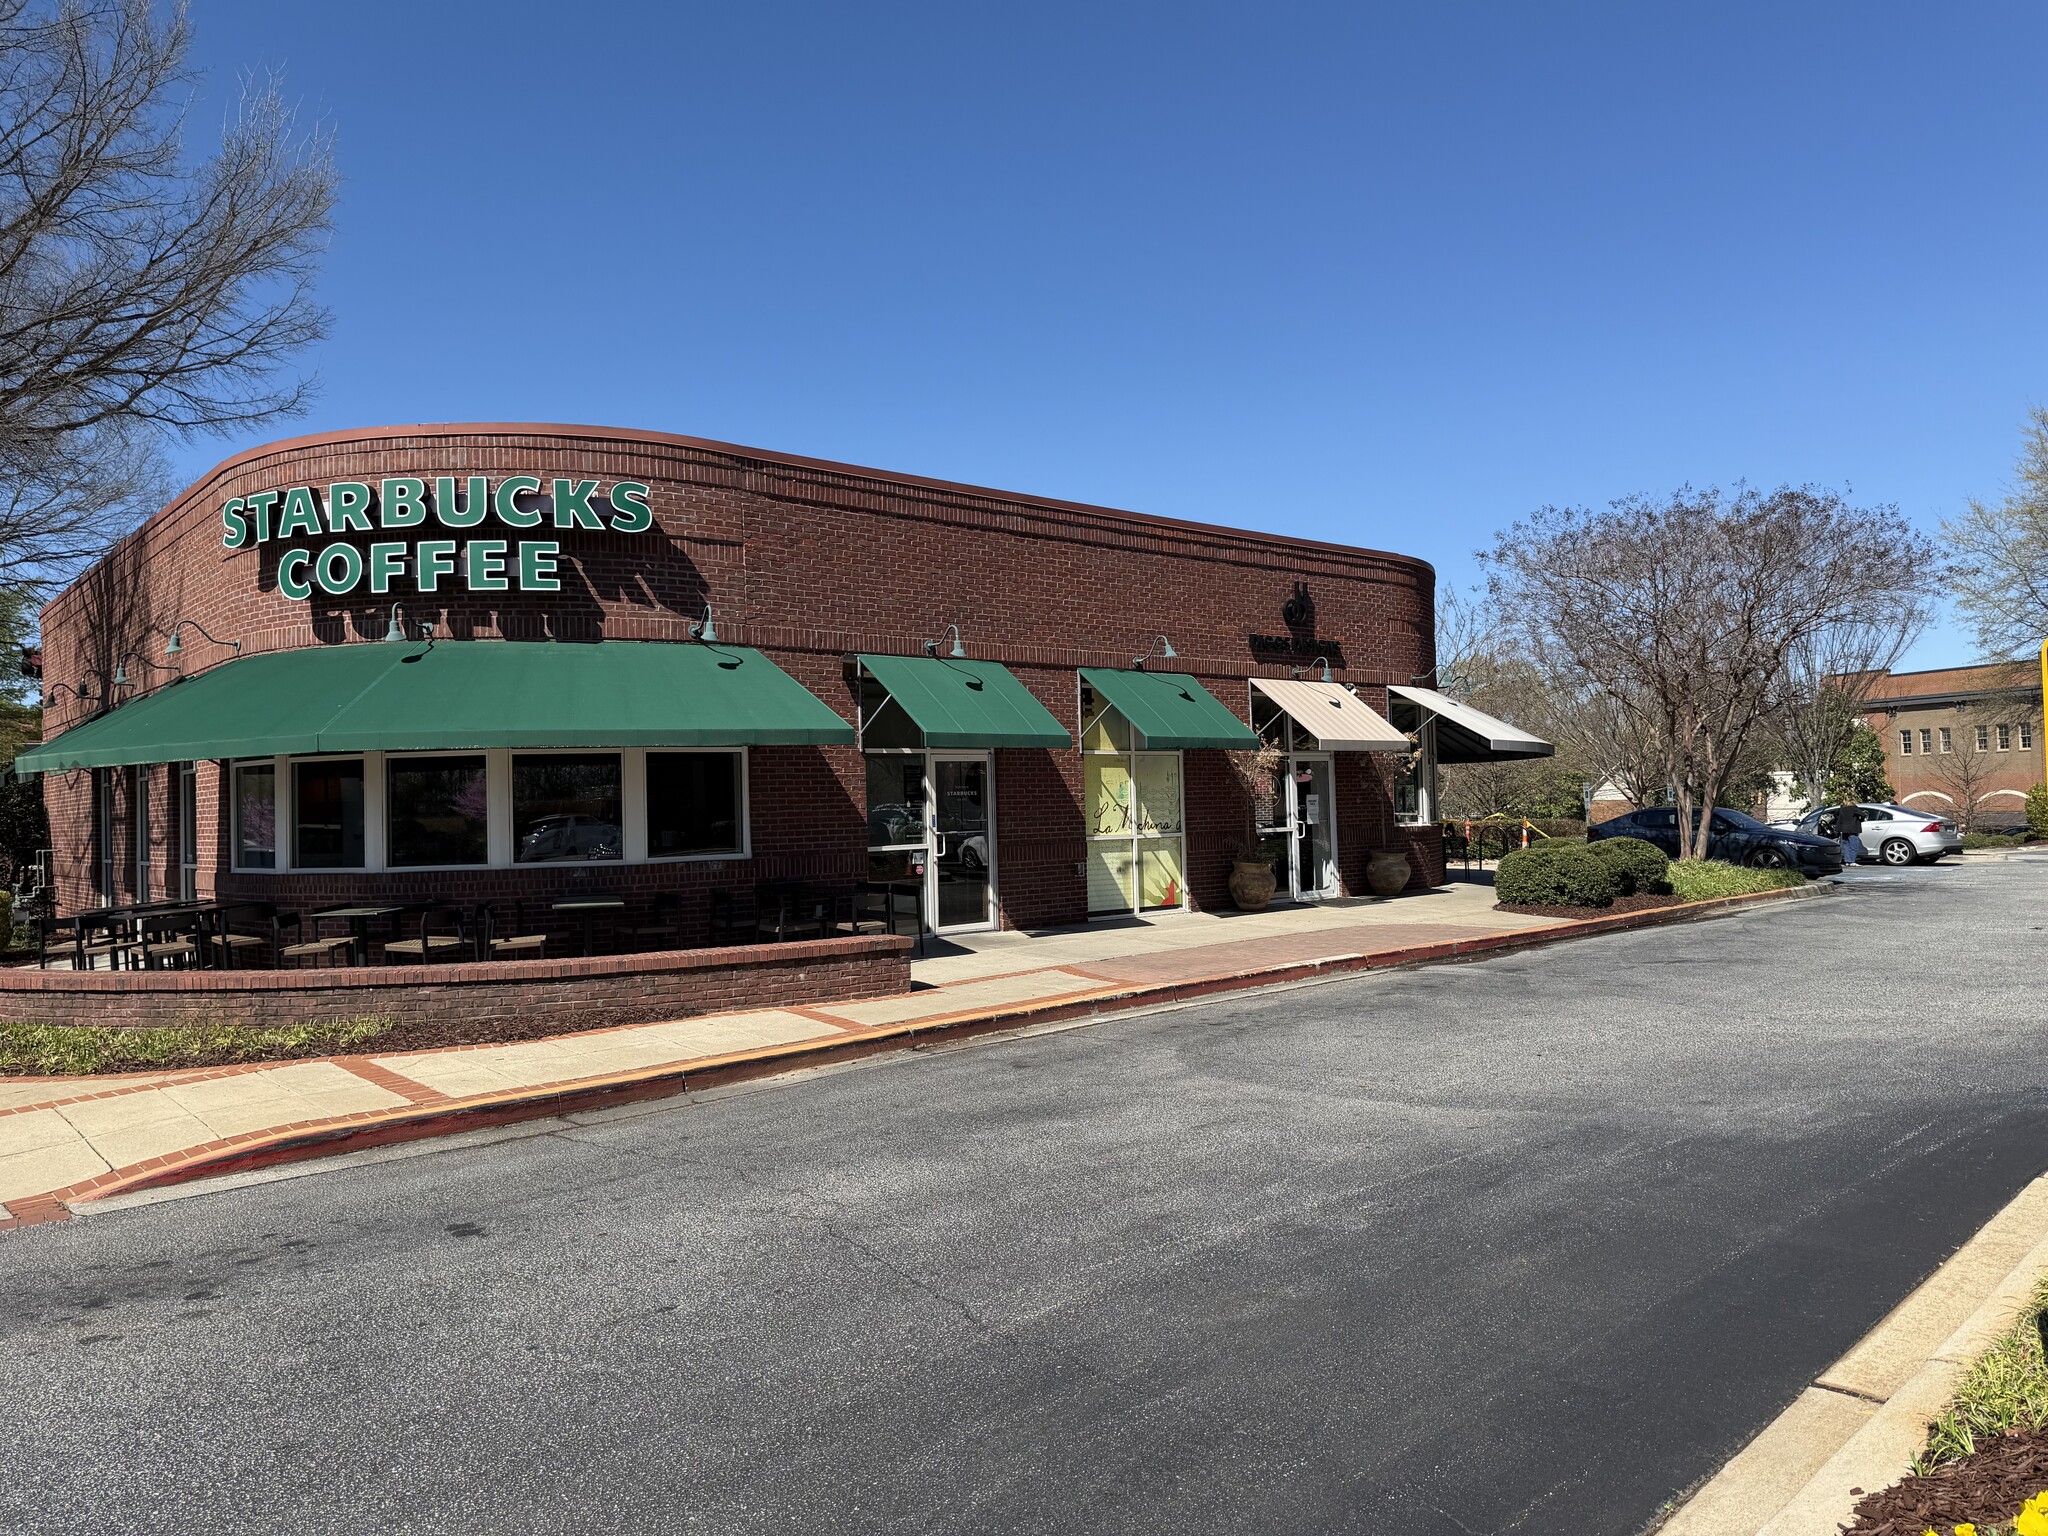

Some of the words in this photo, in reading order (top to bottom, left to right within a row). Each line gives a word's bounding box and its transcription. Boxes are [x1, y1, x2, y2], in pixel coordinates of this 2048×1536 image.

[222, 475, 653, 549] STARBUCKS
[278, 540, 561, 600] COFFEE
[1093, 802, 1114, 833] La
